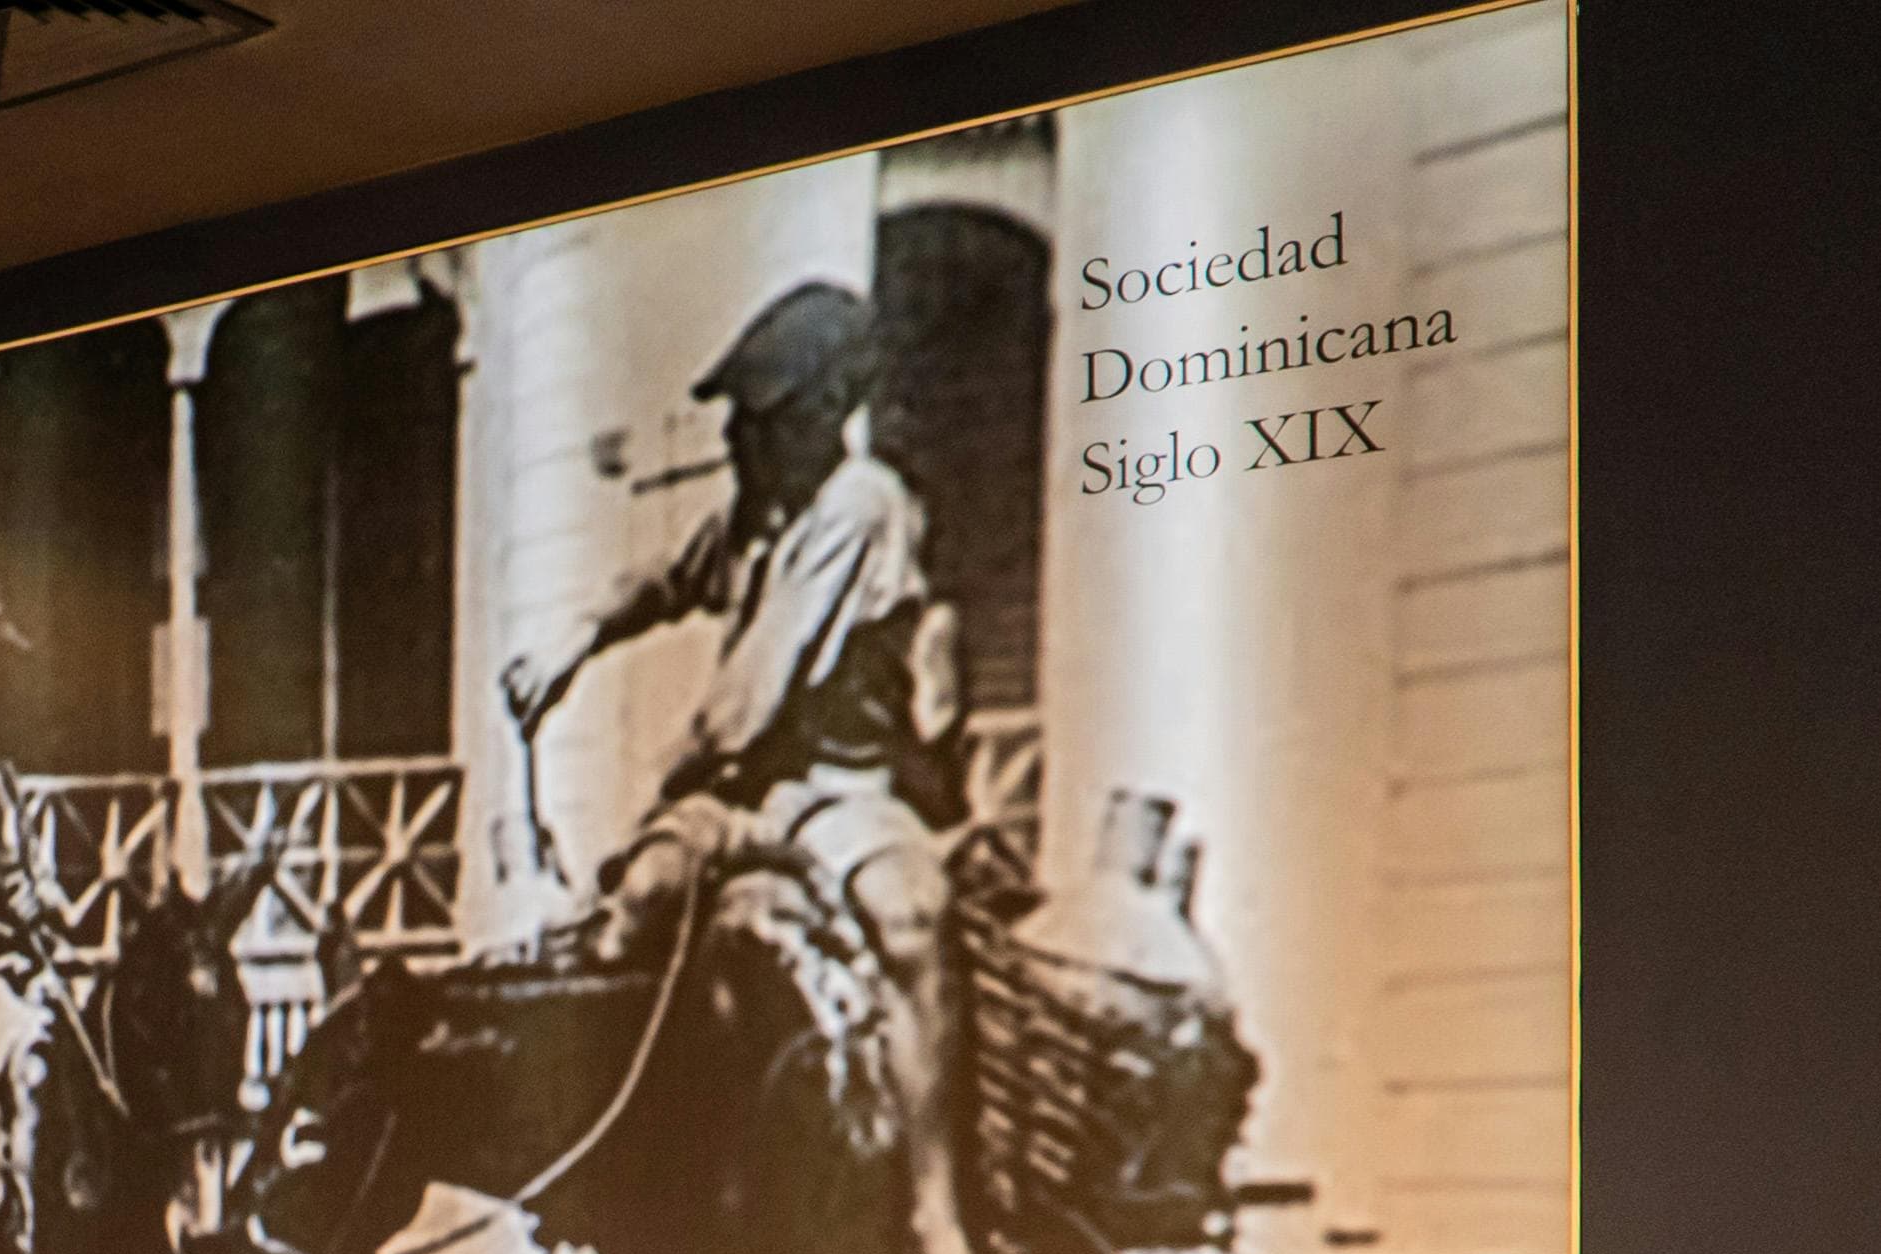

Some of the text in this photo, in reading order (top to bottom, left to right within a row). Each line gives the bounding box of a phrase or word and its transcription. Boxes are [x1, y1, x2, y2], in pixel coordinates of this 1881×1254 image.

[1081, 210, 1348, 311] Sociedad
[1081, 307, 1458, 404] Dominicana
[1081, 399, 1386, 506] Siglo XIX
